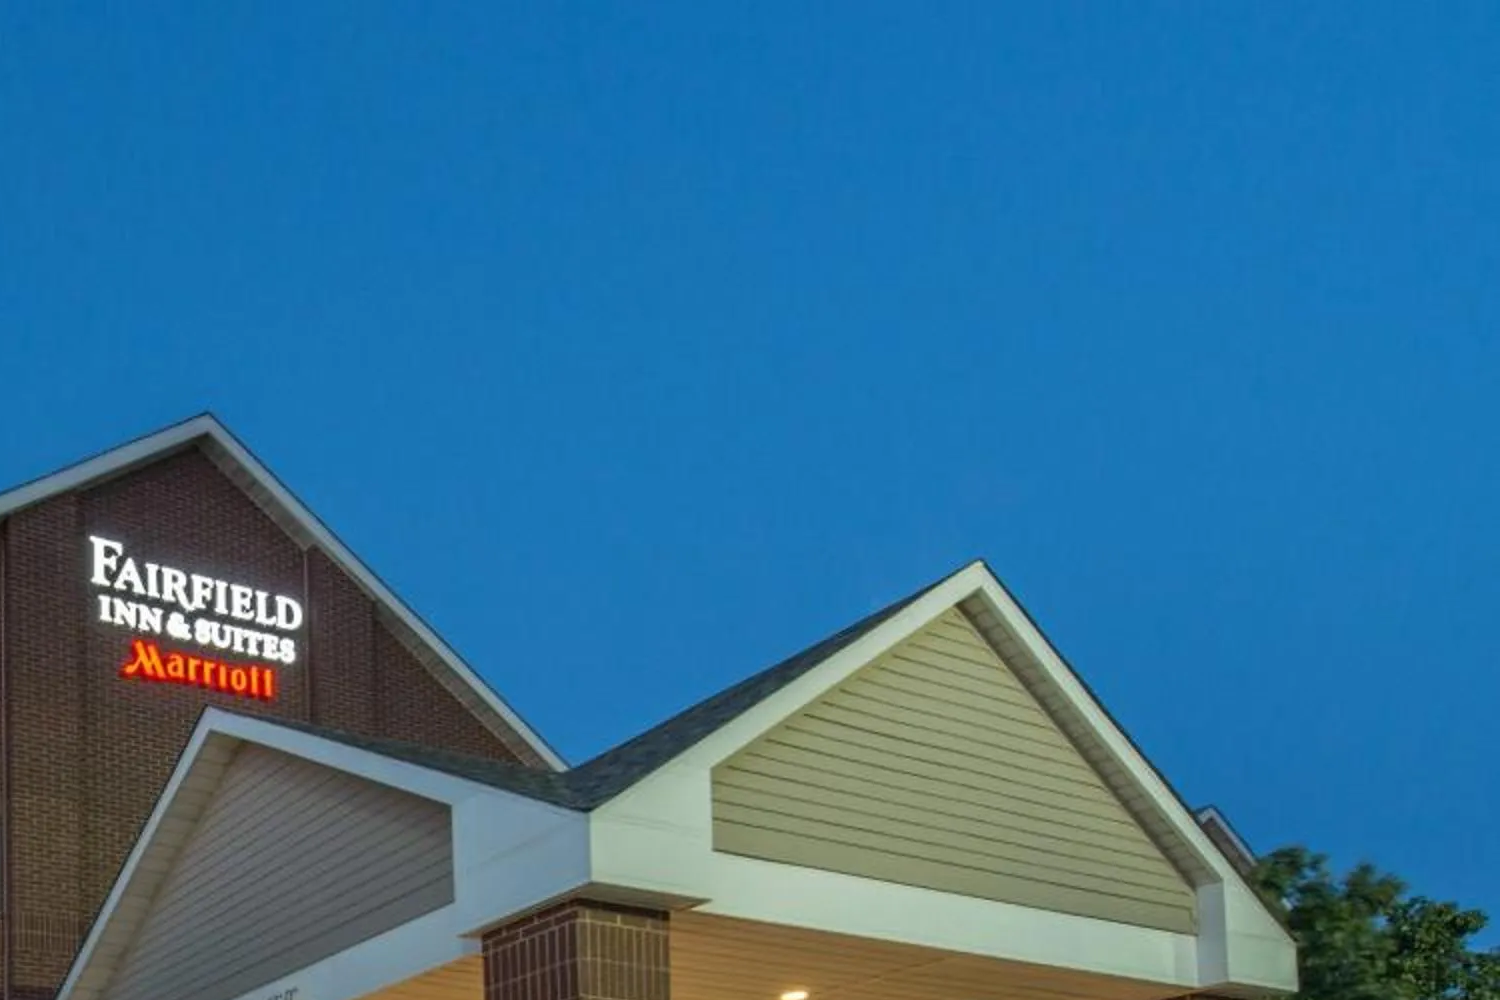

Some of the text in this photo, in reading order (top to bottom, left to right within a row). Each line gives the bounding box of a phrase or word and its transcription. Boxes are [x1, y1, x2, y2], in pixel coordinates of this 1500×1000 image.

[89, 535, 303, 630] FAIRFIELD
[98, 594, 296, 664] INN & SUITES
[122, 637, 274, 698] Marriott
